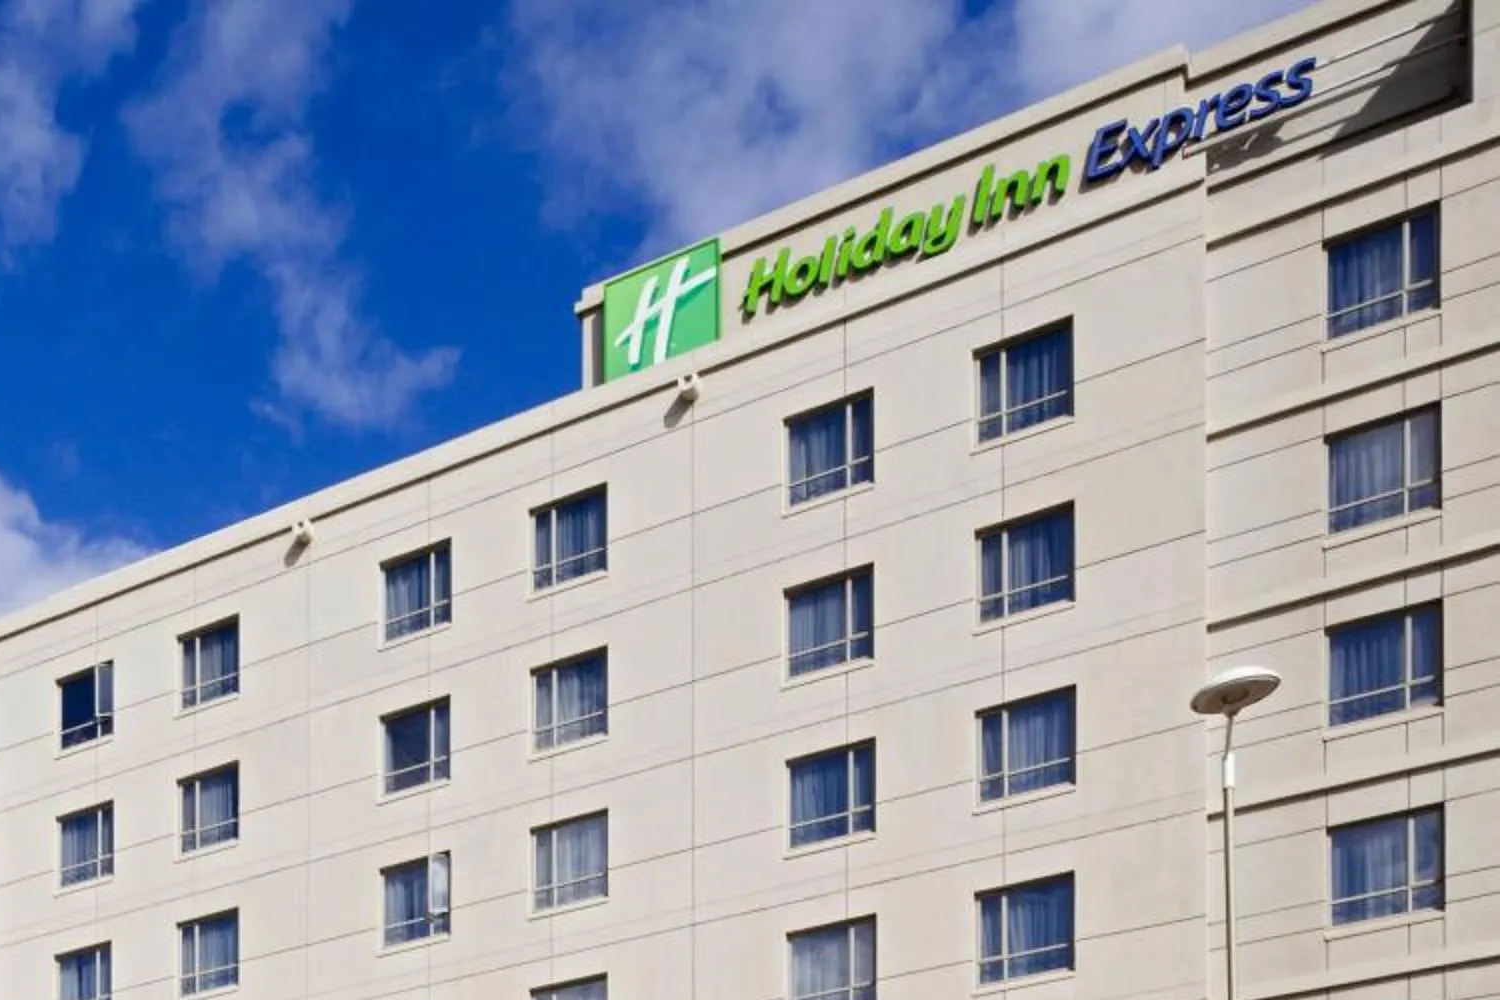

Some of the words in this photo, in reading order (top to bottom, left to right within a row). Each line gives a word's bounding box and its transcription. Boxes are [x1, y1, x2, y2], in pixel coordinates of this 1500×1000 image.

[743, 194, 967, 315] Holiday
[972, 153, 1071, 226] Inn
[1086, 57, 1317, 181] Express
